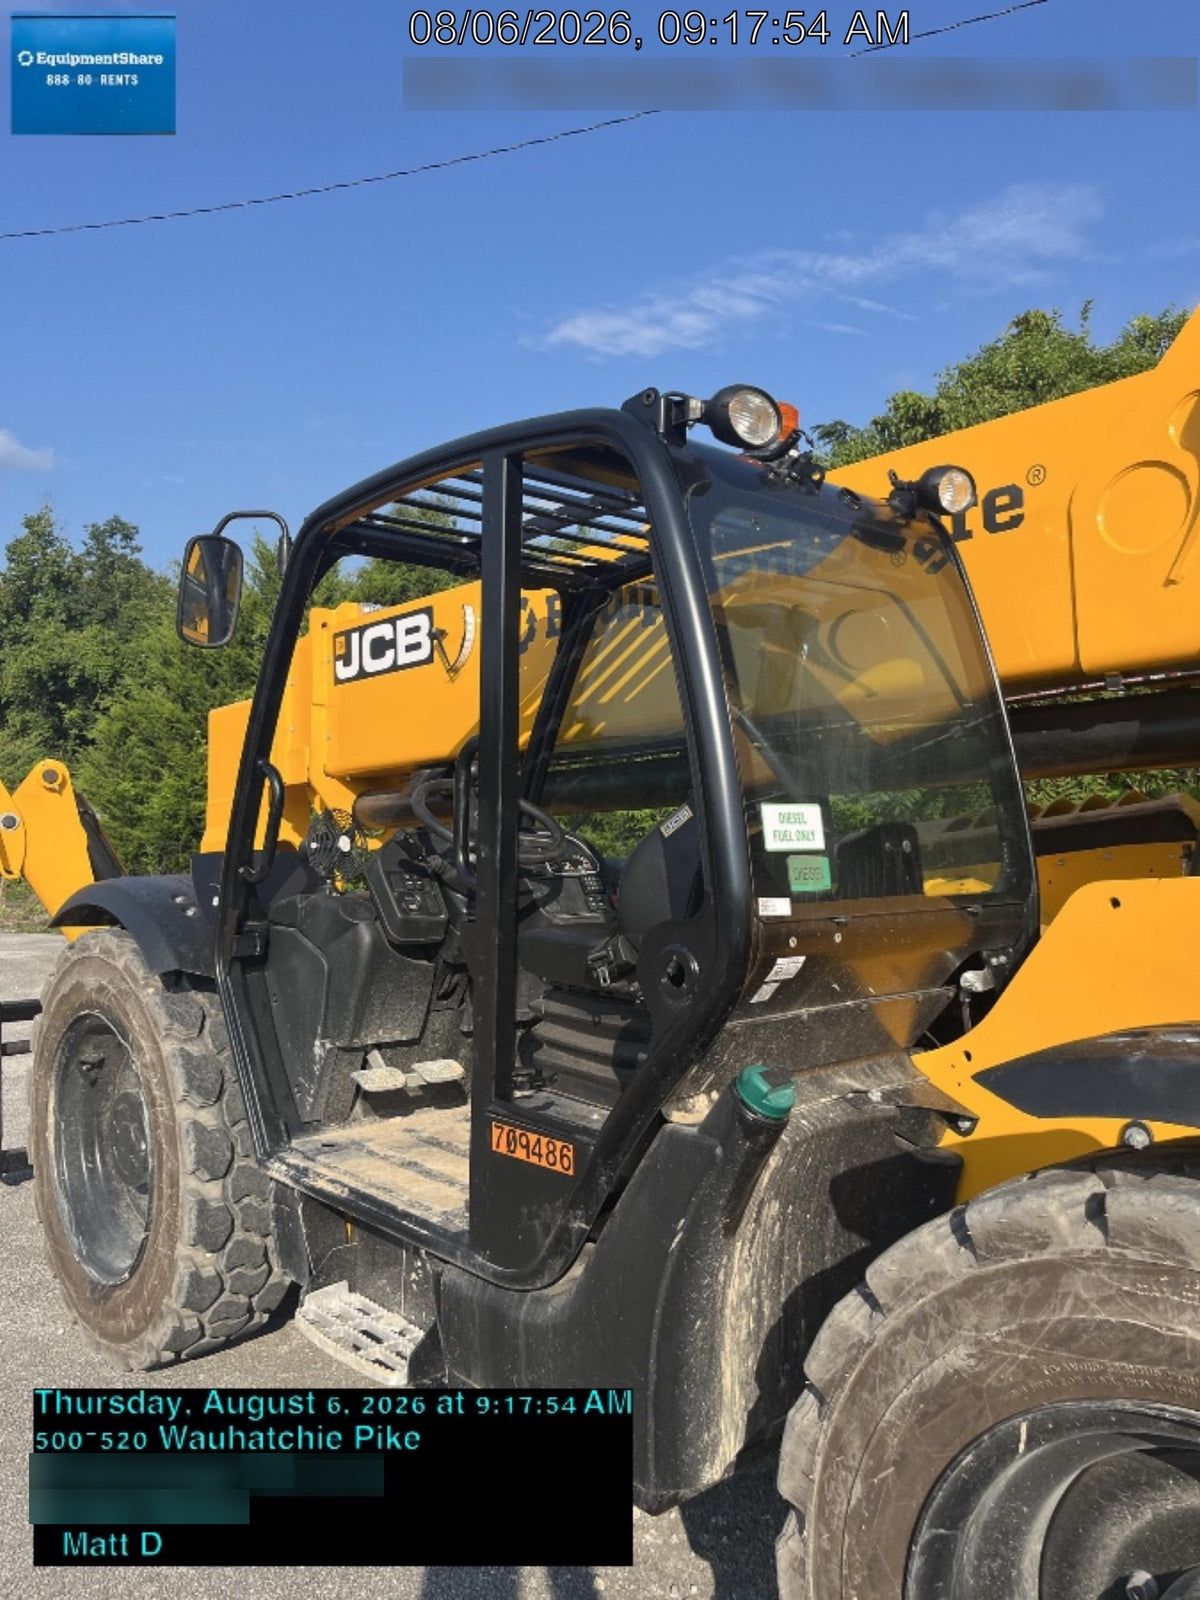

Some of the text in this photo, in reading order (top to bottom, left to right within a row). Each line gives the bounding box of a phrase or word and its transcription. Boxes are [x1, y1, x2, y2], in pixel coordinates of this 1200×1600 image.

[335, 613, 432, 680] JCB
[778, 812, 807, 824] DIESEL
[773, 830, 815, 842] FUEL ONLY
[493, 1124, 572, 1172] 709486
